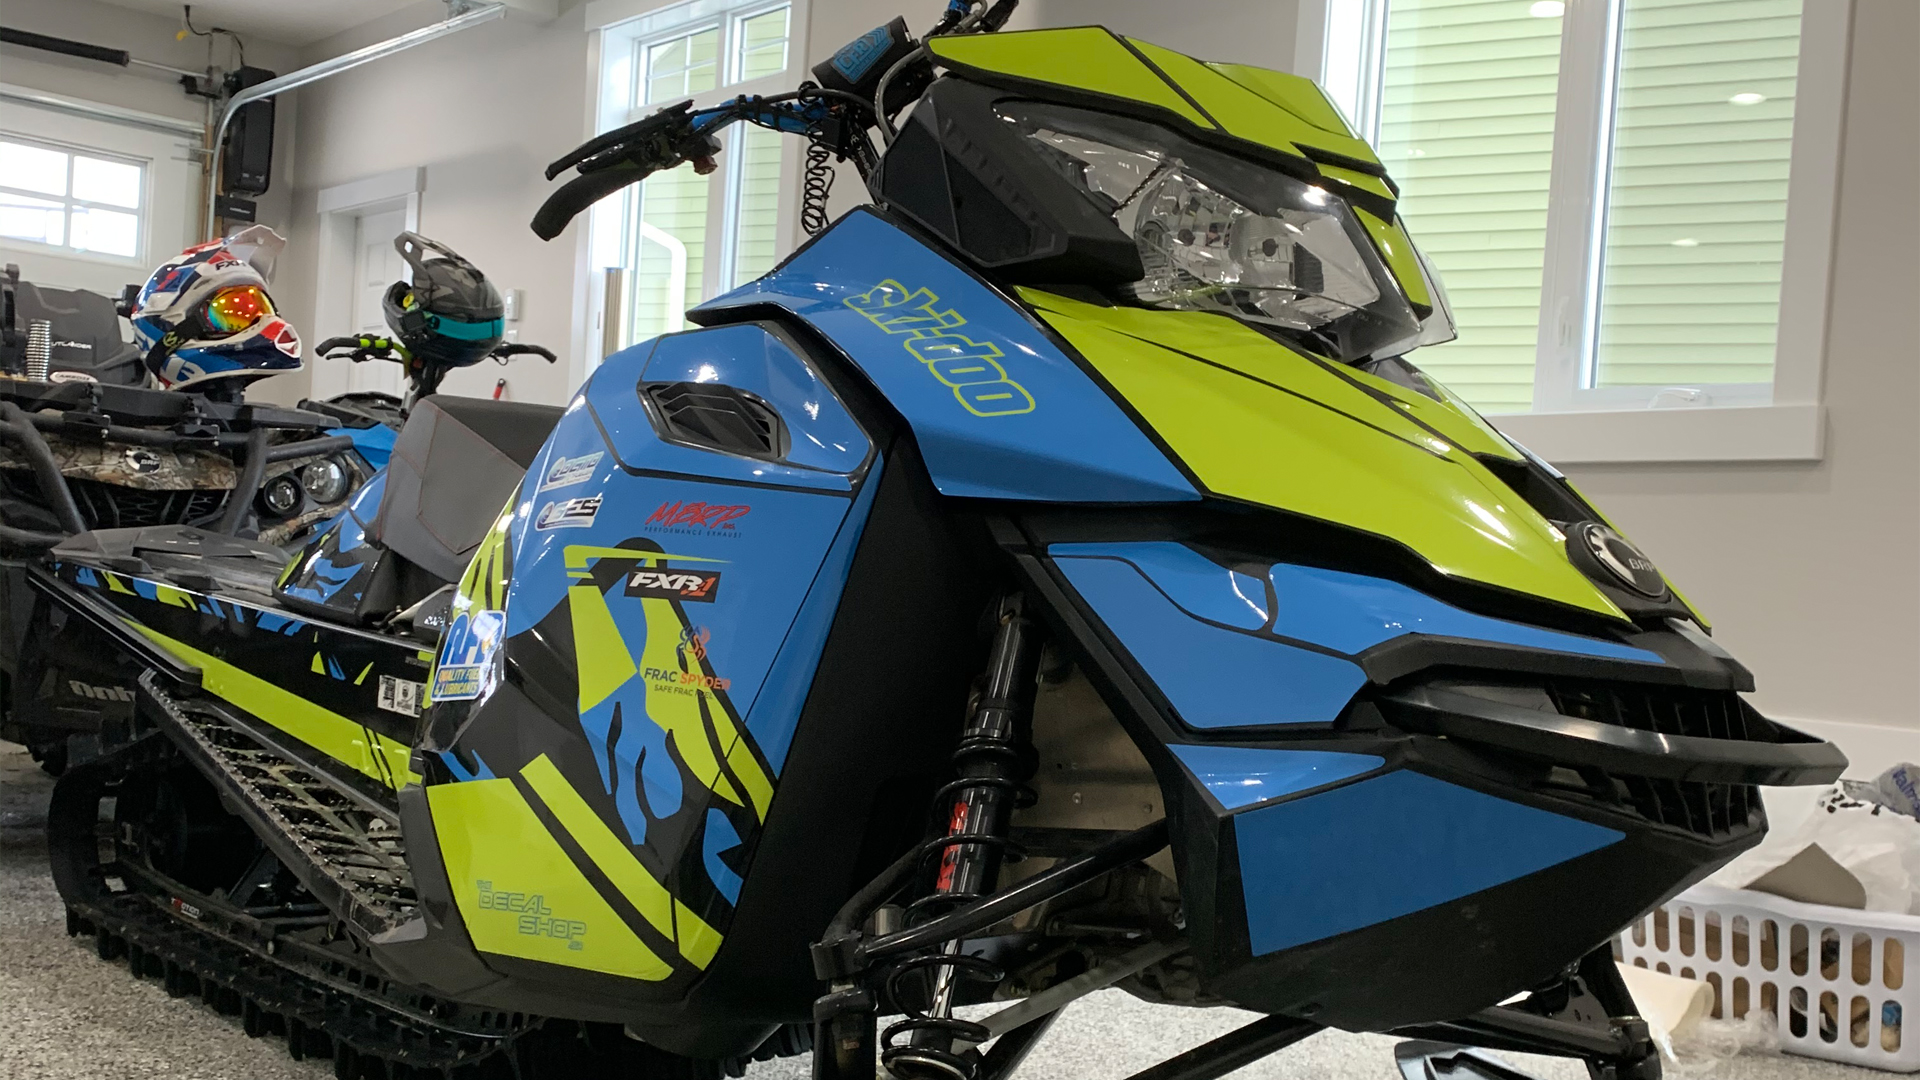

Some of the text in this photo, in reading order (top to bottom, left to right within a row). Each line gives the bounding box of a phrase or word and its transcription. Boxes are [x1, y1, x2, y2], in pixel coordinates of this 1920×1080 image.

[843, 279, 1036, 417] ski-doo
[645, 500, 751, 529] MBRP
[644, 526, 742, 539] PERFORMANCE EXHAUST
[644, 667, 732, 691] FRAC SPYDER
[654, 684, 672, 693] SAFE
[673, 686, 694, 697] FRAC
[478, 890, 552, 916] DECAL
[518, 915, 587, 940] SHOP
